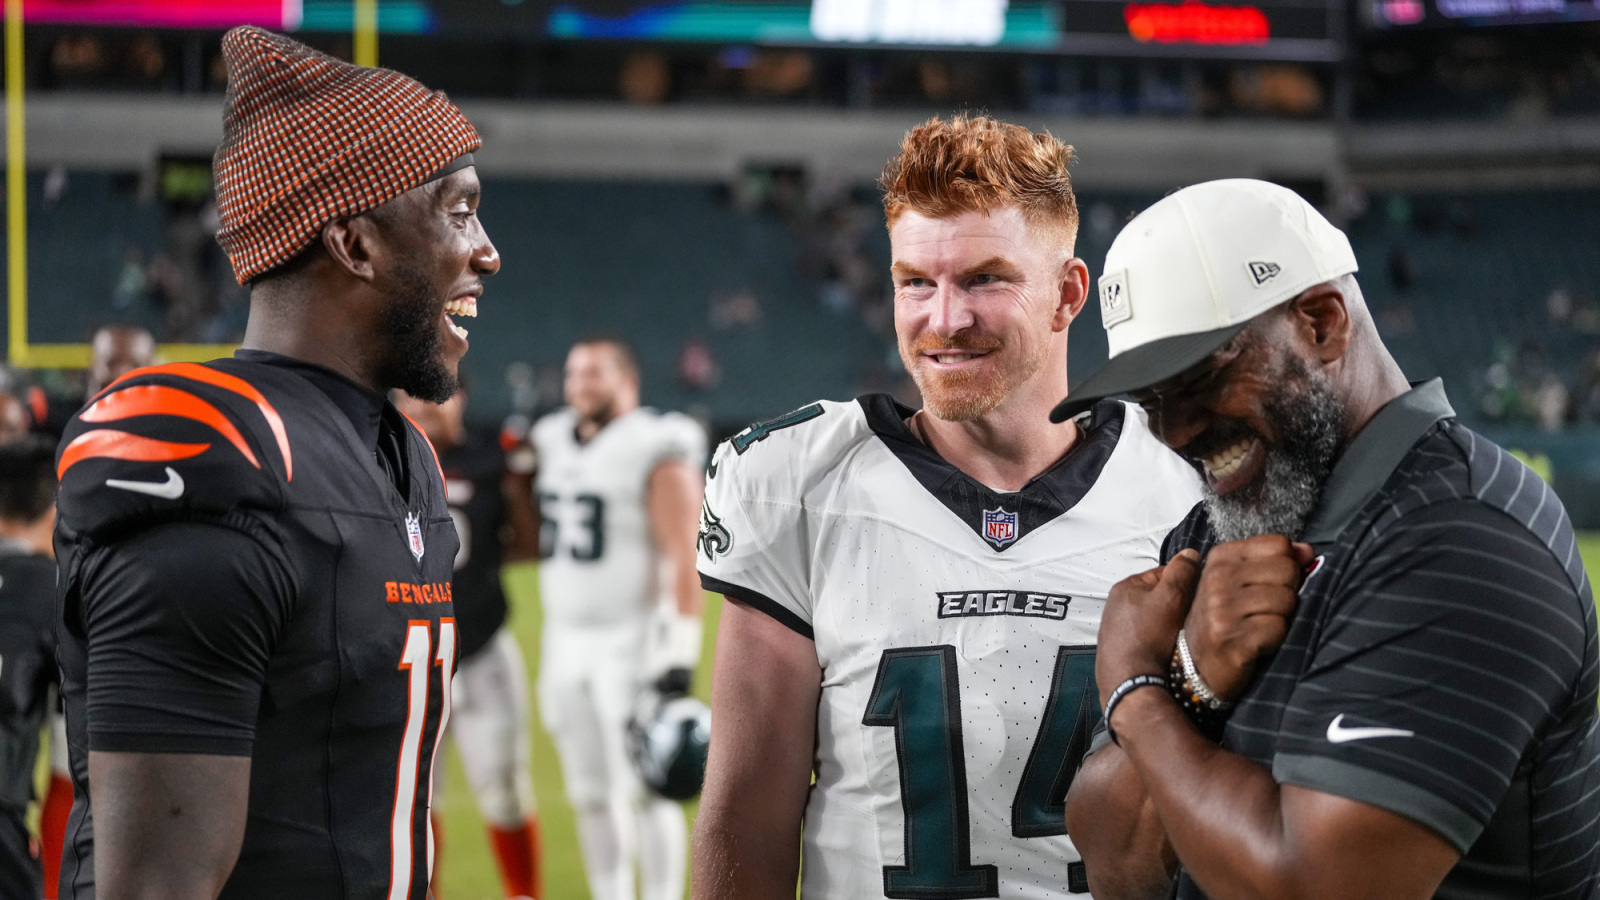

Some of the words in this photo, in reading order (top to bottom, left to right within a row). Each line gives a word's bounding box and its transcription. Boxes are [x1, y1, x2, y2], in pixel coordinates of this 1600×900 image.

[988, 521, 1013, 539] NFL
[384, 580, 452, 605] BENGALS
[938, 590, 1070, 619] EAGLES
[387, 616, 457, 900] 11
[861, 643, 1104, 900] 14
